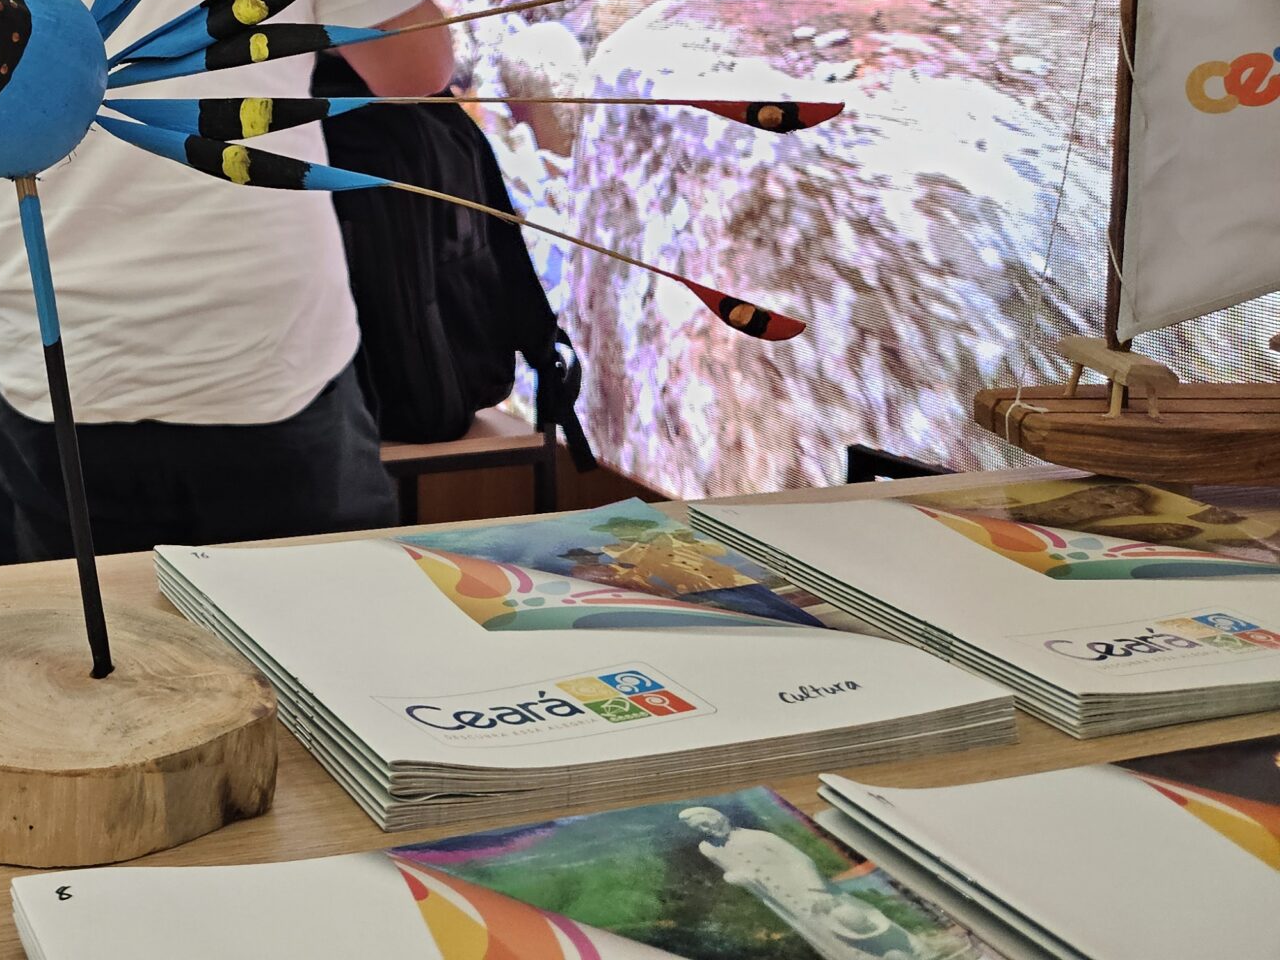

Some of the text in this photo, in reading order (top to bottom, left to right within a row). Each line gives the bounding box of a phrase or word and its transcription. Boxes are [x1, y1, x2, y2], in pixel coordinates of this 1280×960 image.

[1185, 46, 1280, 114] ce
[1043, 626, 1203, 662] Ceará
[405, 690, 586, 731] Ceará
[55, 885, 73, 901] 8
